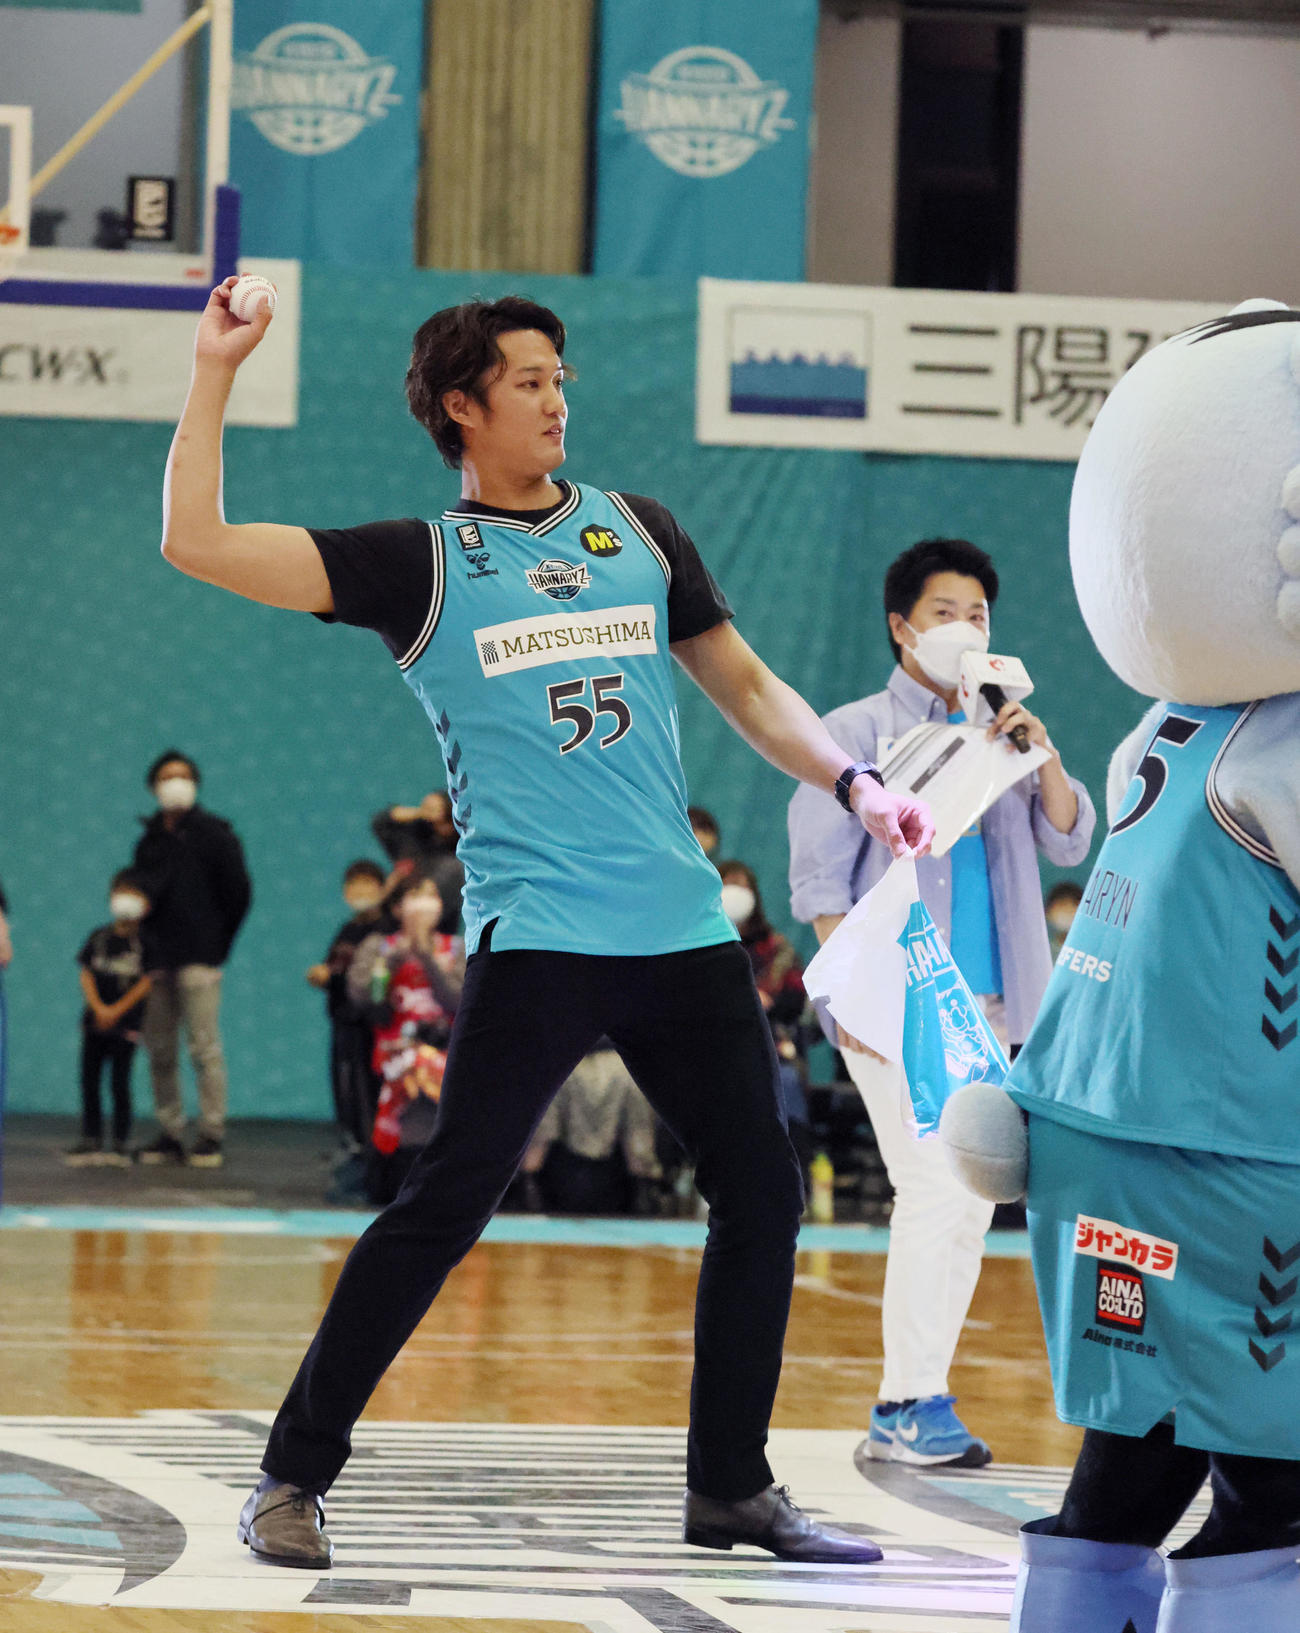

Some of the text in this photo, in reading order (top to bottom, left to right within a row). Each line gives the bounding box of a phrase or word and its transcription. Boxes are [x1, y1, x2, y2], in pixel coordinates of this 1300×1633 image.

[901, 321, 1170, 427] 三陽
[527, 567, 592, 589] HANNARYZ
[501, 621, 652, 658] MATSUSHIMA
[546, 672, 632, 756] 55
[1076, 1222, 1174, 1272] ジャンカラ
[1100, 1275, 1144, 1302] AINA
